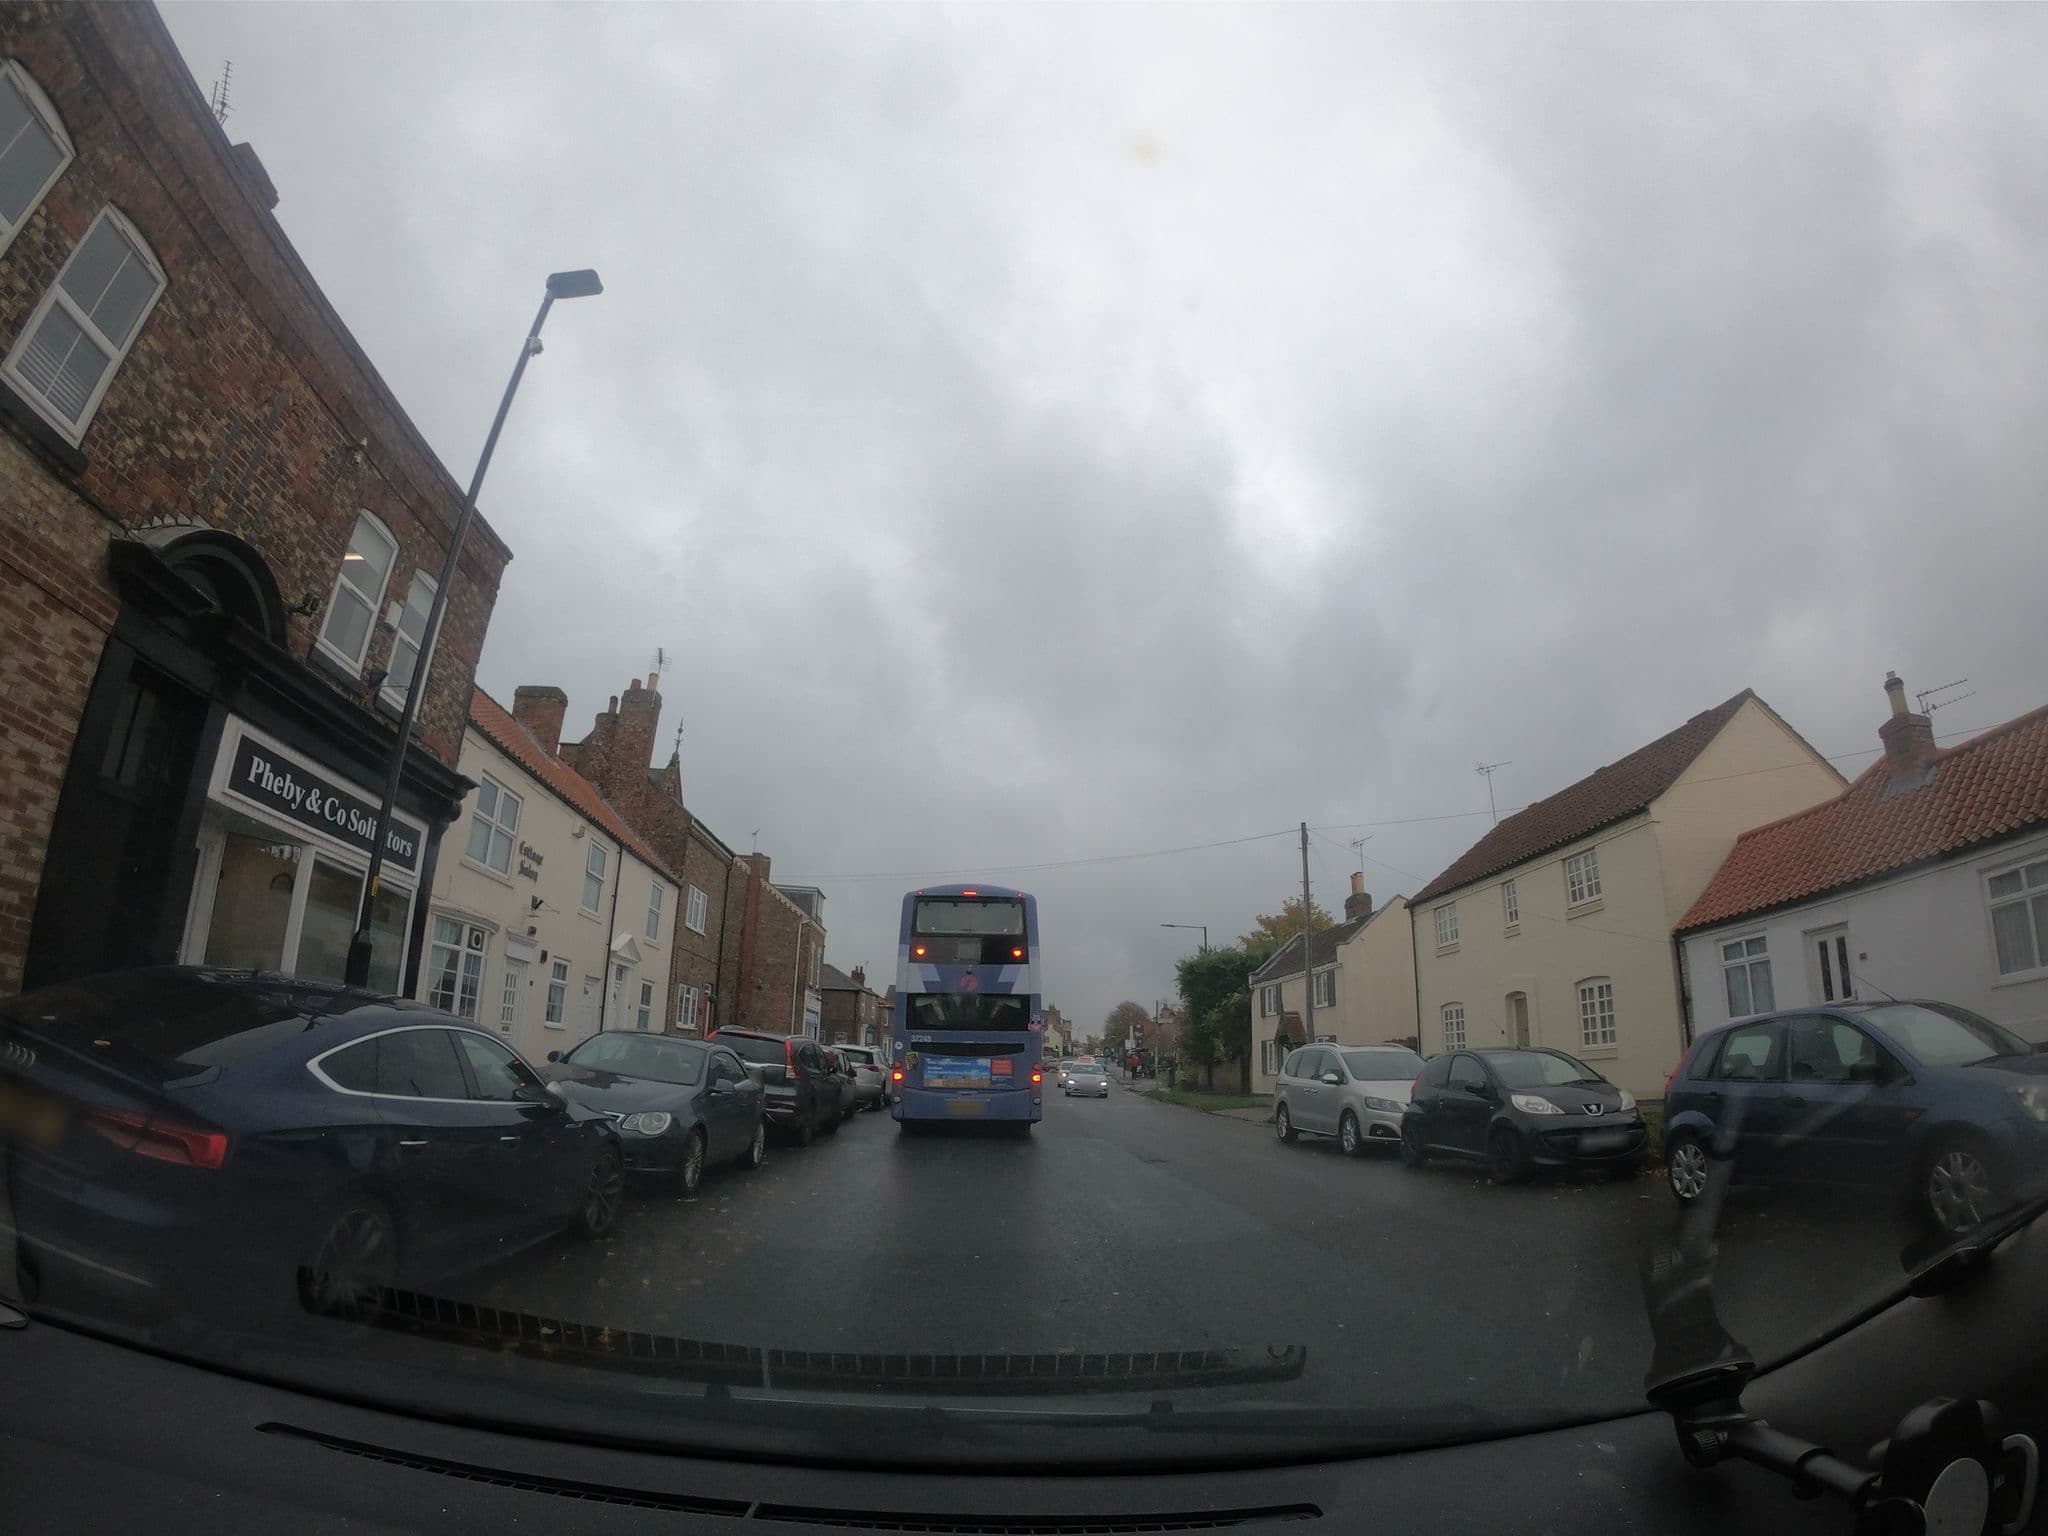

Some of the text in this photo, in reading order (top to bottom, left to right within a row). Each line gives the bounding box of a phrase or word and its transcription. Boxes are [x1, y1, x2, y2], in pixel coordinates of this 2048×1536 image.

[247, 755, 413, 857] Pheby & Co Solitors
